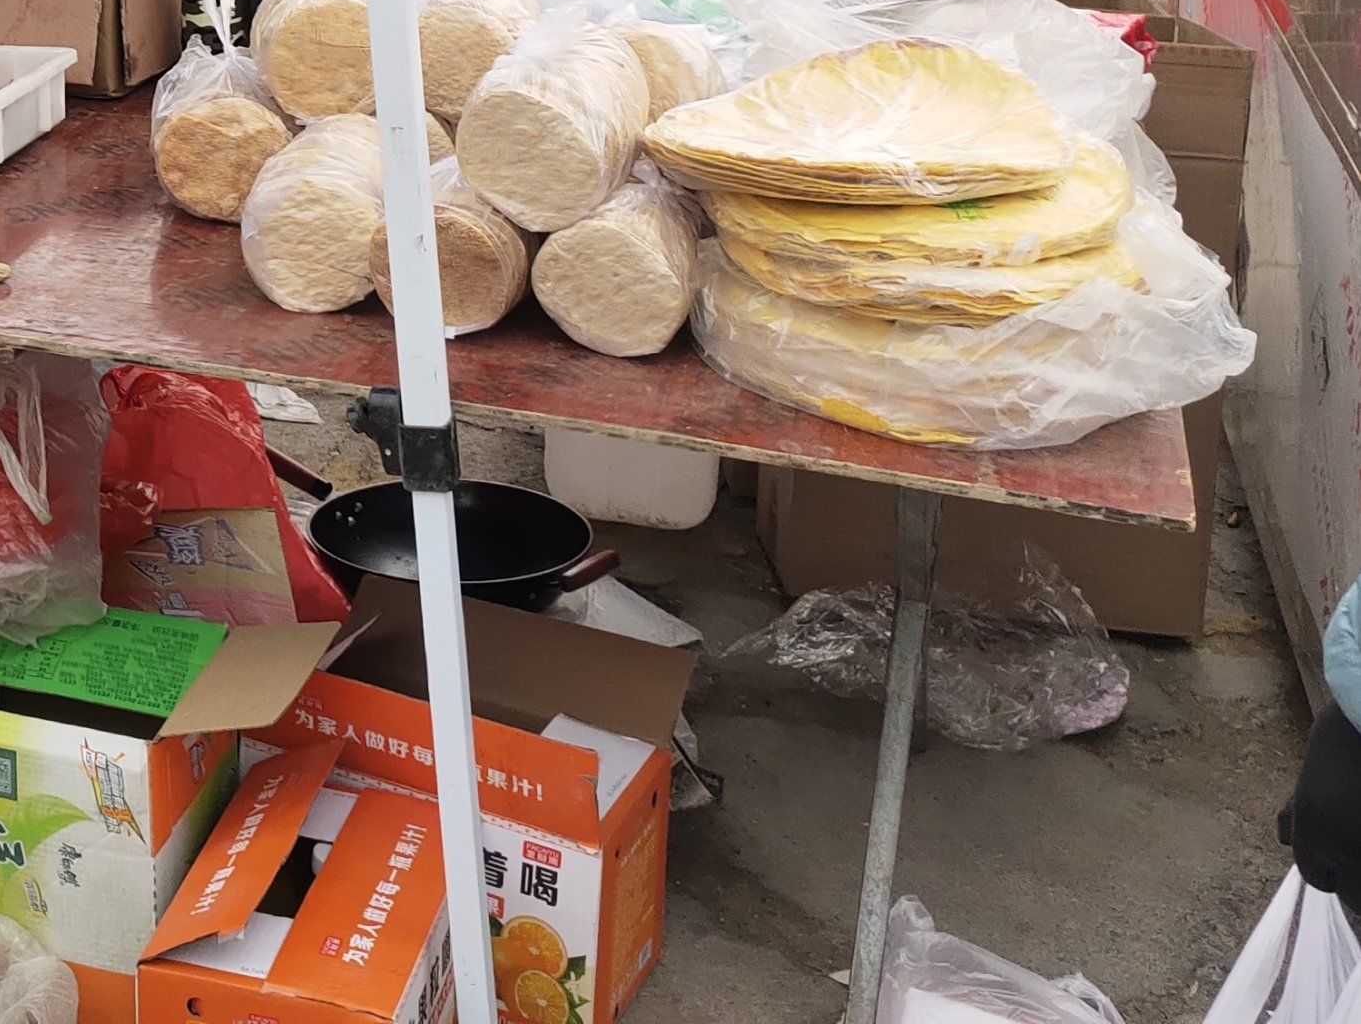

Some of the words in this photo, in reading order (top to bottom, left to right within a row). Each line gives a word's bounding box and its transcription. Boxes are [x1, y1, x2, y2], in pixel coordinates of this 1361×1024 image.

[294, 707, 543, 801] 为家人做好每果汁!
[342, 823, 428, 967] 为家人做好每一瓶果汁!
